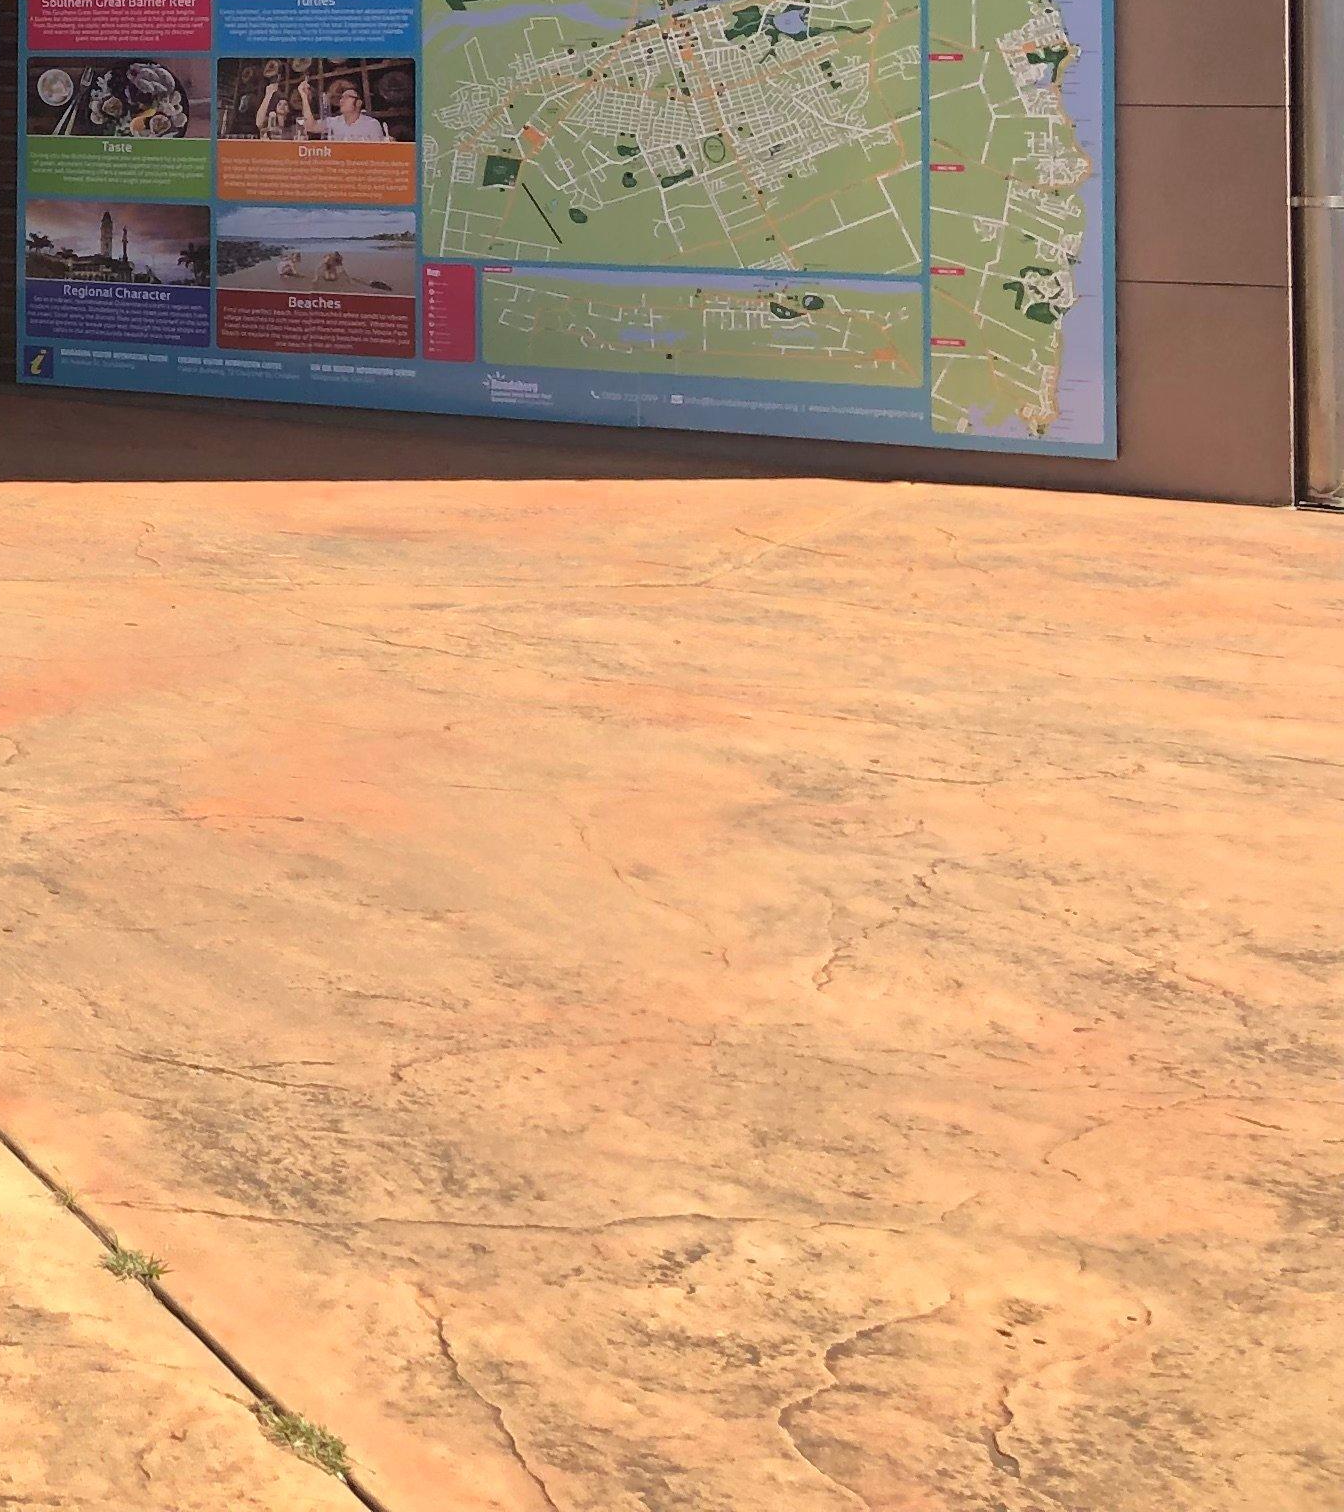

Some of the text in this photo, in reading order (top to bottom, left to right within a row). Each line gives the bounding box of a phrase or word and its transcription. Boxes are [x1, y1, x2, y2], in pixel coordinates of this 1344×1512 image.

[101, 140, 133, 153] Taste
[298, 145, 332, 157] Drink
[63, 284, 171, 301] Regional Character
[288, 296, 342, 309] Beaches
